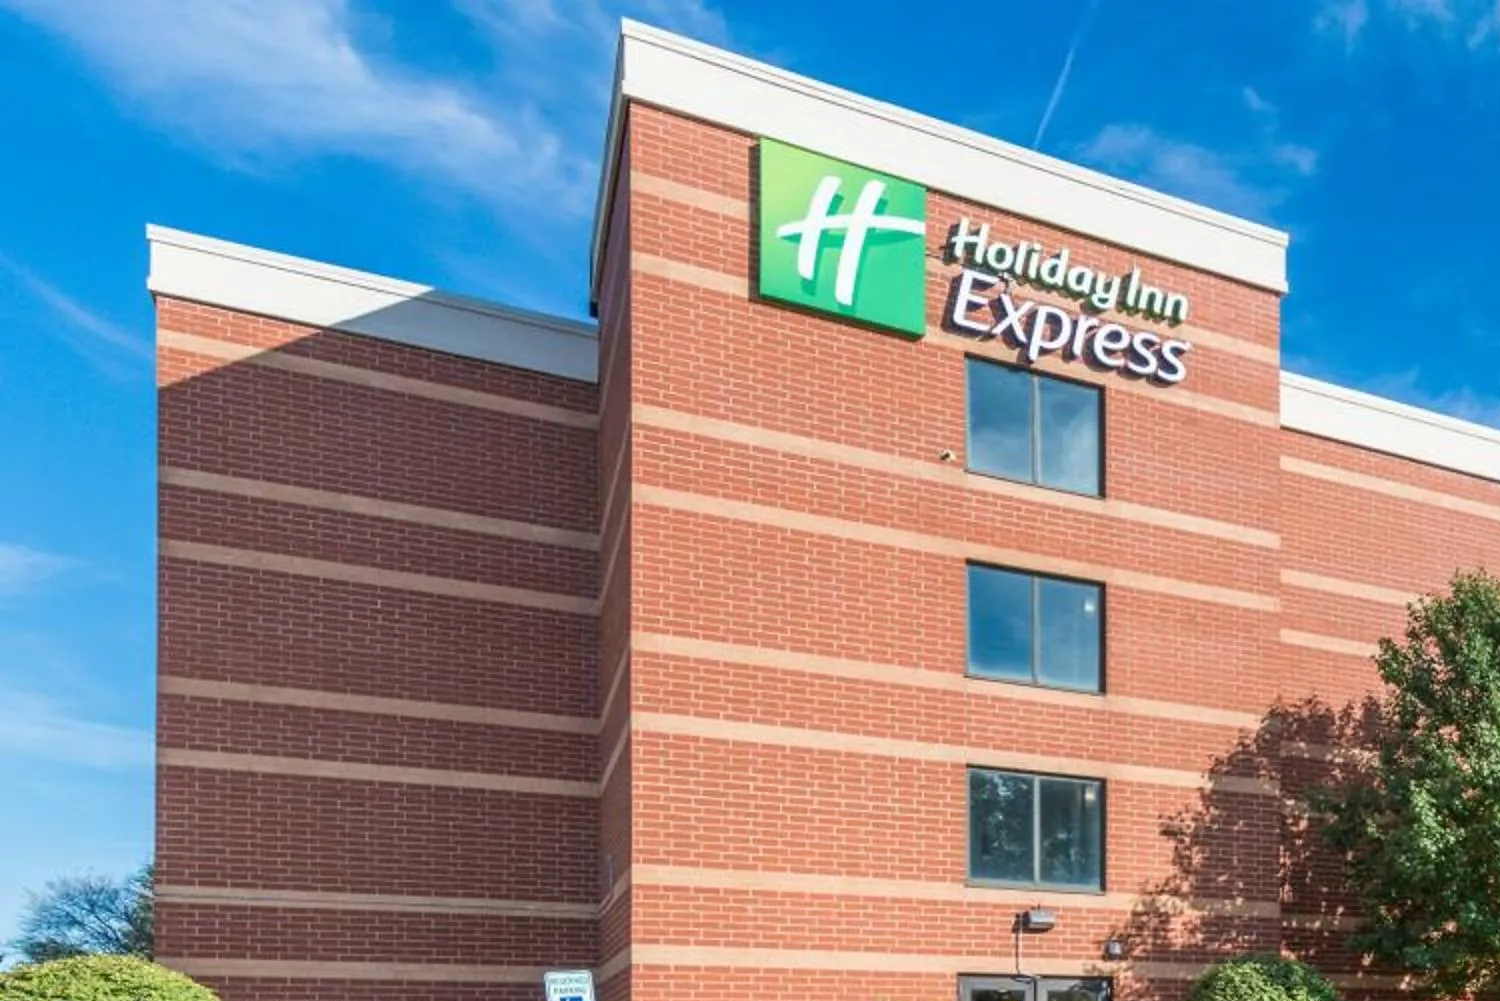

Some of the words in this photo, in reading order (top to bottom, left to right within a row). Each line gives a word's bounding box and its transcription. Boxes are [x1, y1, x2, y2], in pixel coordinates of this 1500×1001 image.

[951, 217, 1123, 309] Holiday
[1128, 267, 1189, 322] Inn
[951, 269, 1192, 383] Express
